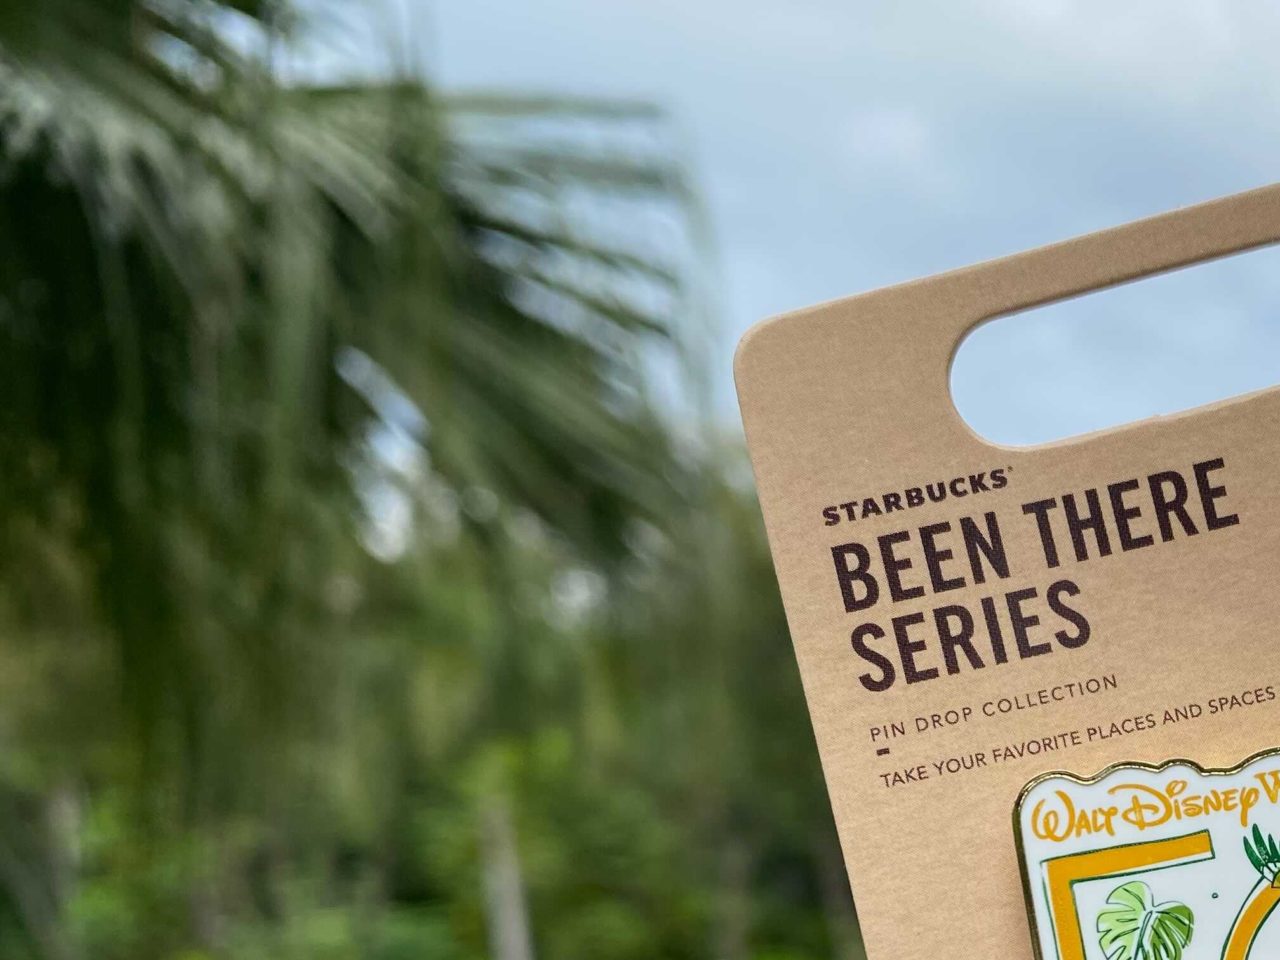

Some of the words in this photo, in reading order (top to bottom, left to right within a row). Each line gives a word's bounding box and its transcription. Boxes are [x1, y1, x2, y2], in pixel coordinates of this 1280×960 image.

[831, 511, 1011, 613] BEEN
[1022, 457, 1240, 569] THERE
[850, 579, 1092, 693] SERIES
[870, 721, 906, 742] PIN
[915, 707, 972, 733] DROP
[982, 674, 1118, 718] COLLECTION
[880, 765, 930, 788] TAKE
[932, 752, 988, 777] YOUR
[993, 731, 1082, 764] FAVORITE
[1087, 713, 1157, 742] PLACES
[1162, 703, 1203, 726] AND
[1208, 686, 1277, 715] SPACES
